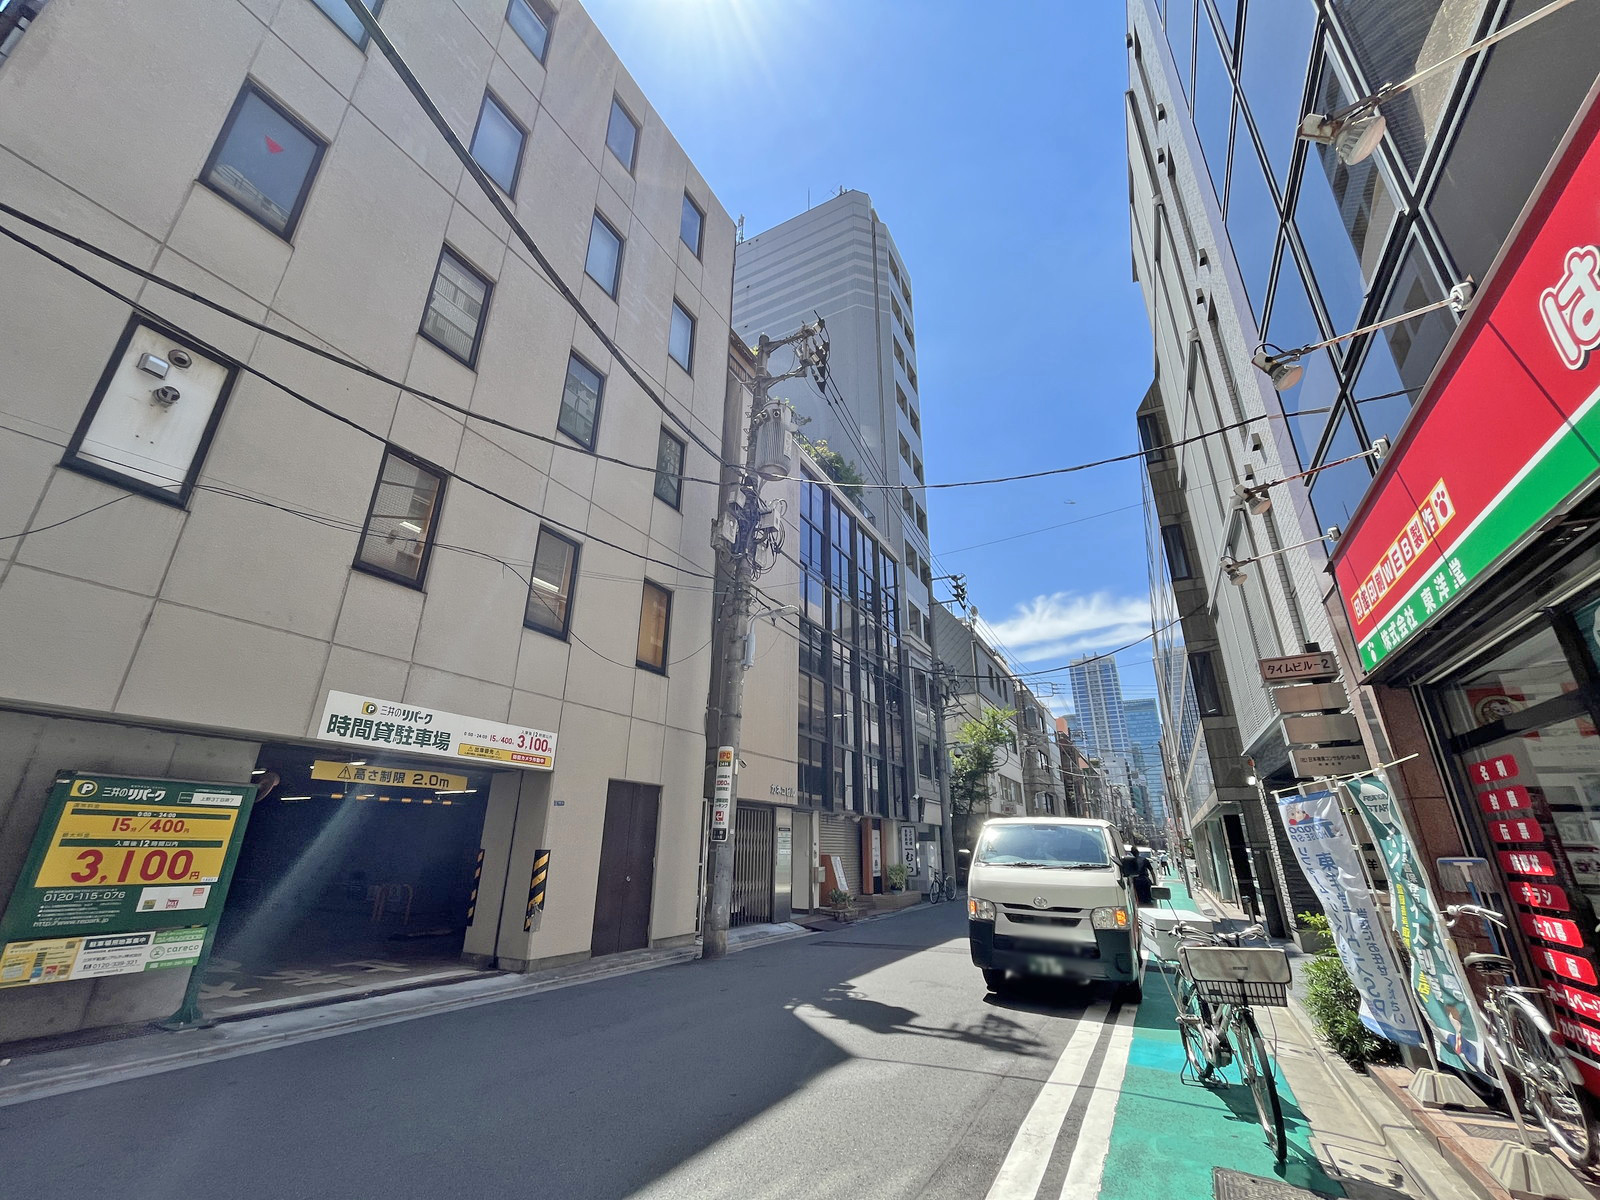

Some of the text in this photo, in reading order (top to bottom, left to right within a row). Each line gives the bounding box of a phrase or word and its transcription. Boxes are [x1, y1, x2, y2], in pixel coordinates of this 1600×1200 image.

[1380, 557, 1467, 652] 株式会社 東洋堂
[380, 705, 433, 725] 三井のリパーク
[326, 714, 451, 751] 時間貸駐車場
[517, 735, 552, 753] 3,100円
[353, 767, 449, 788] 高さ制限 2.0m
[102, 787, 166, 801] 三井のリパーク
[70, 849, 200, 884] 3,100円
[43, 892, 126, 902] 0120-115-076
[1522, 886, 1553, 905] チラシ
[1533, 917, 1567, 943] たれ幕
[166, 944, 199, 953] careco
